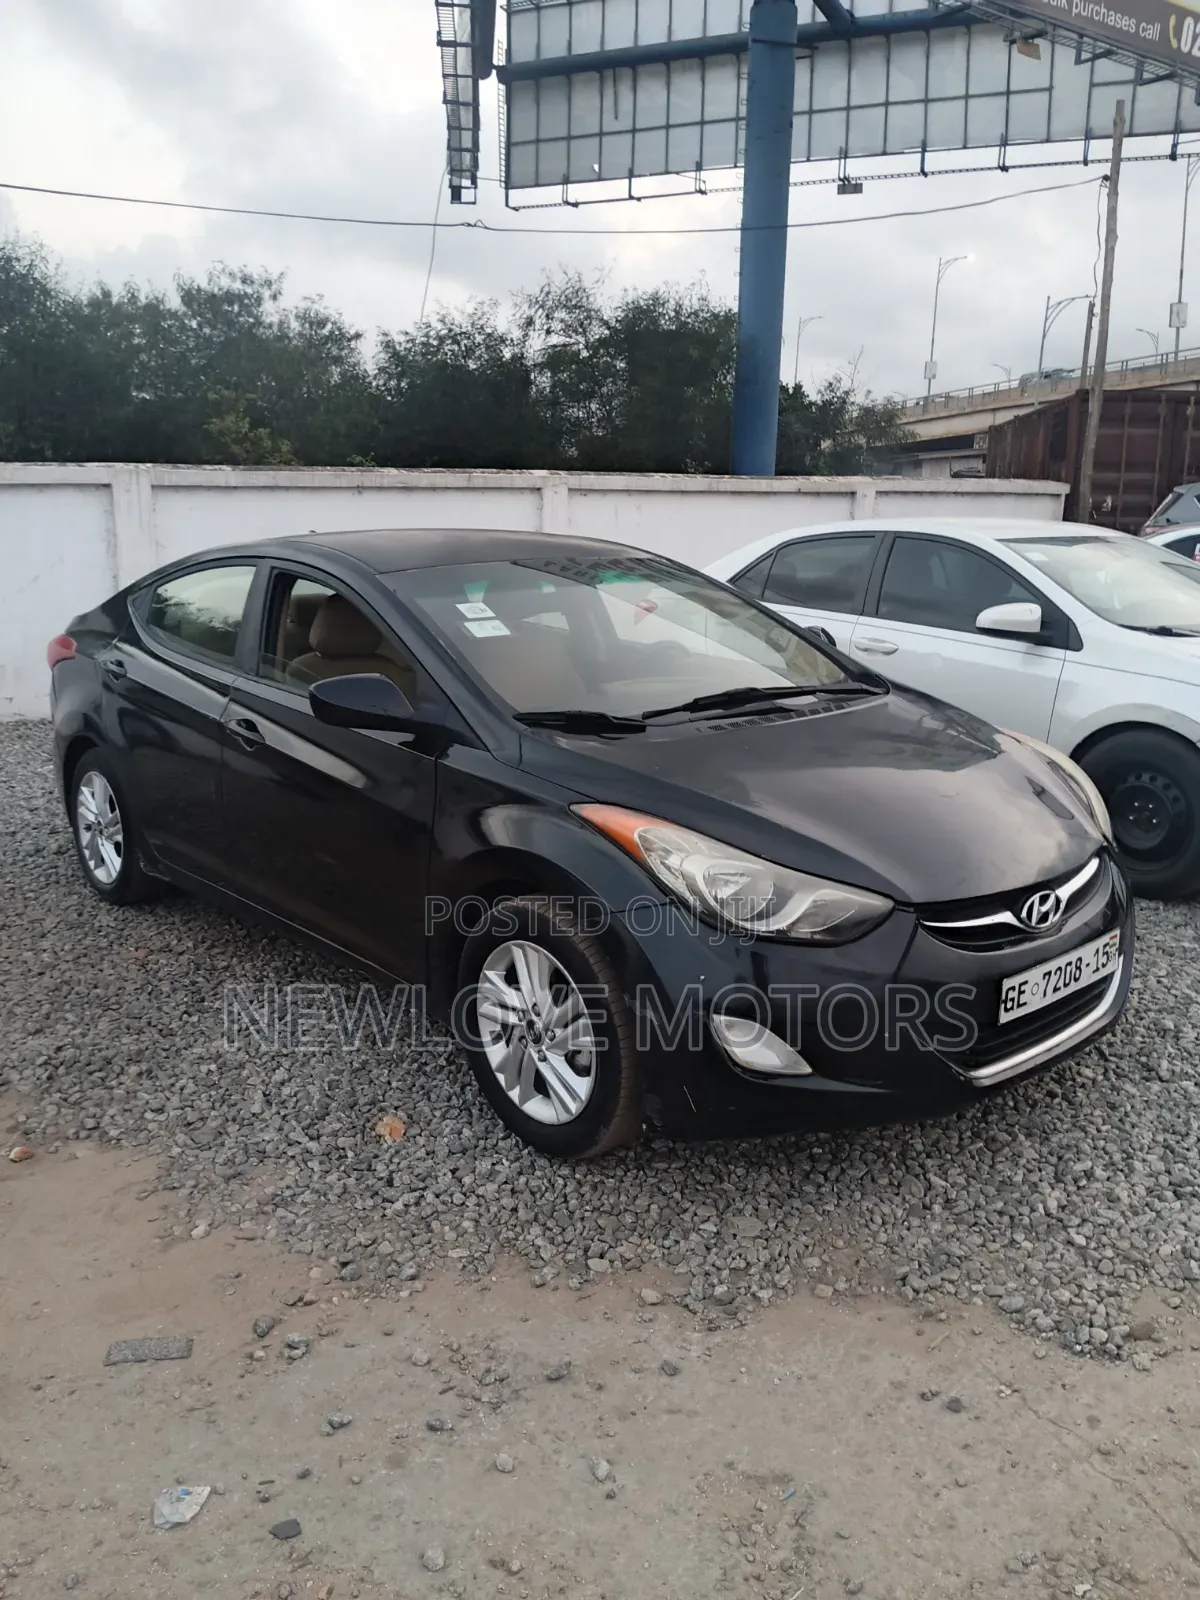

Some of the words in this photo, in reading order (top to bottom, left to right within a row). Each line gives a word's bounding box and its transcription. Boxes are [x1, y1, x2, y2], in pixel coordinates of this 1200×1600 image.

[1072, 0, 1136, 33] purchases
[1139, 21, 1161, 41] call
[1003, 980, 1029, 1013] GE
